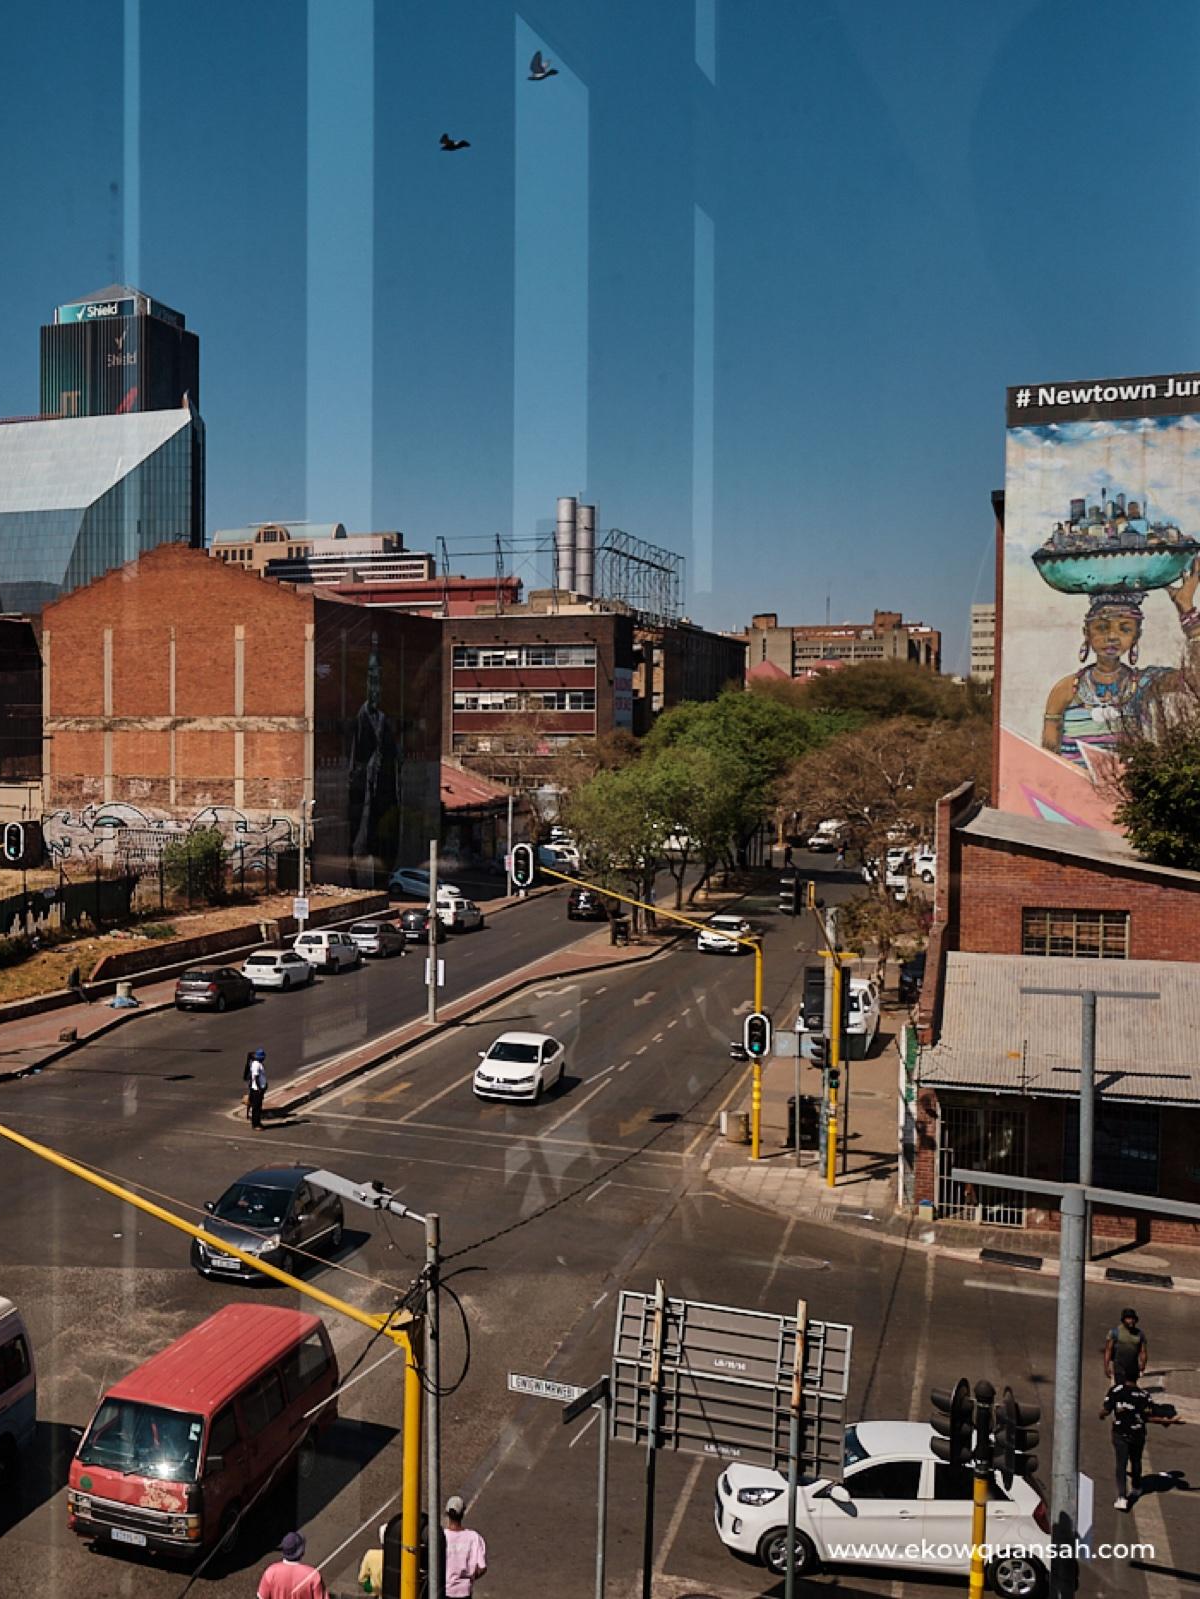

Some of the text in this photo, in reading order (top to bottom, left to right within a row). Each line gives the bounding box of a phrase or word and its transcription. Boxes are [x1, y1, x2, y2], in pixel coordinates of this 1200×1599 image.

[86, 303, 118, 318] Shield
[1015, 388, 1031, 408] #
[1038, 383, 1156, 407] Newtown
